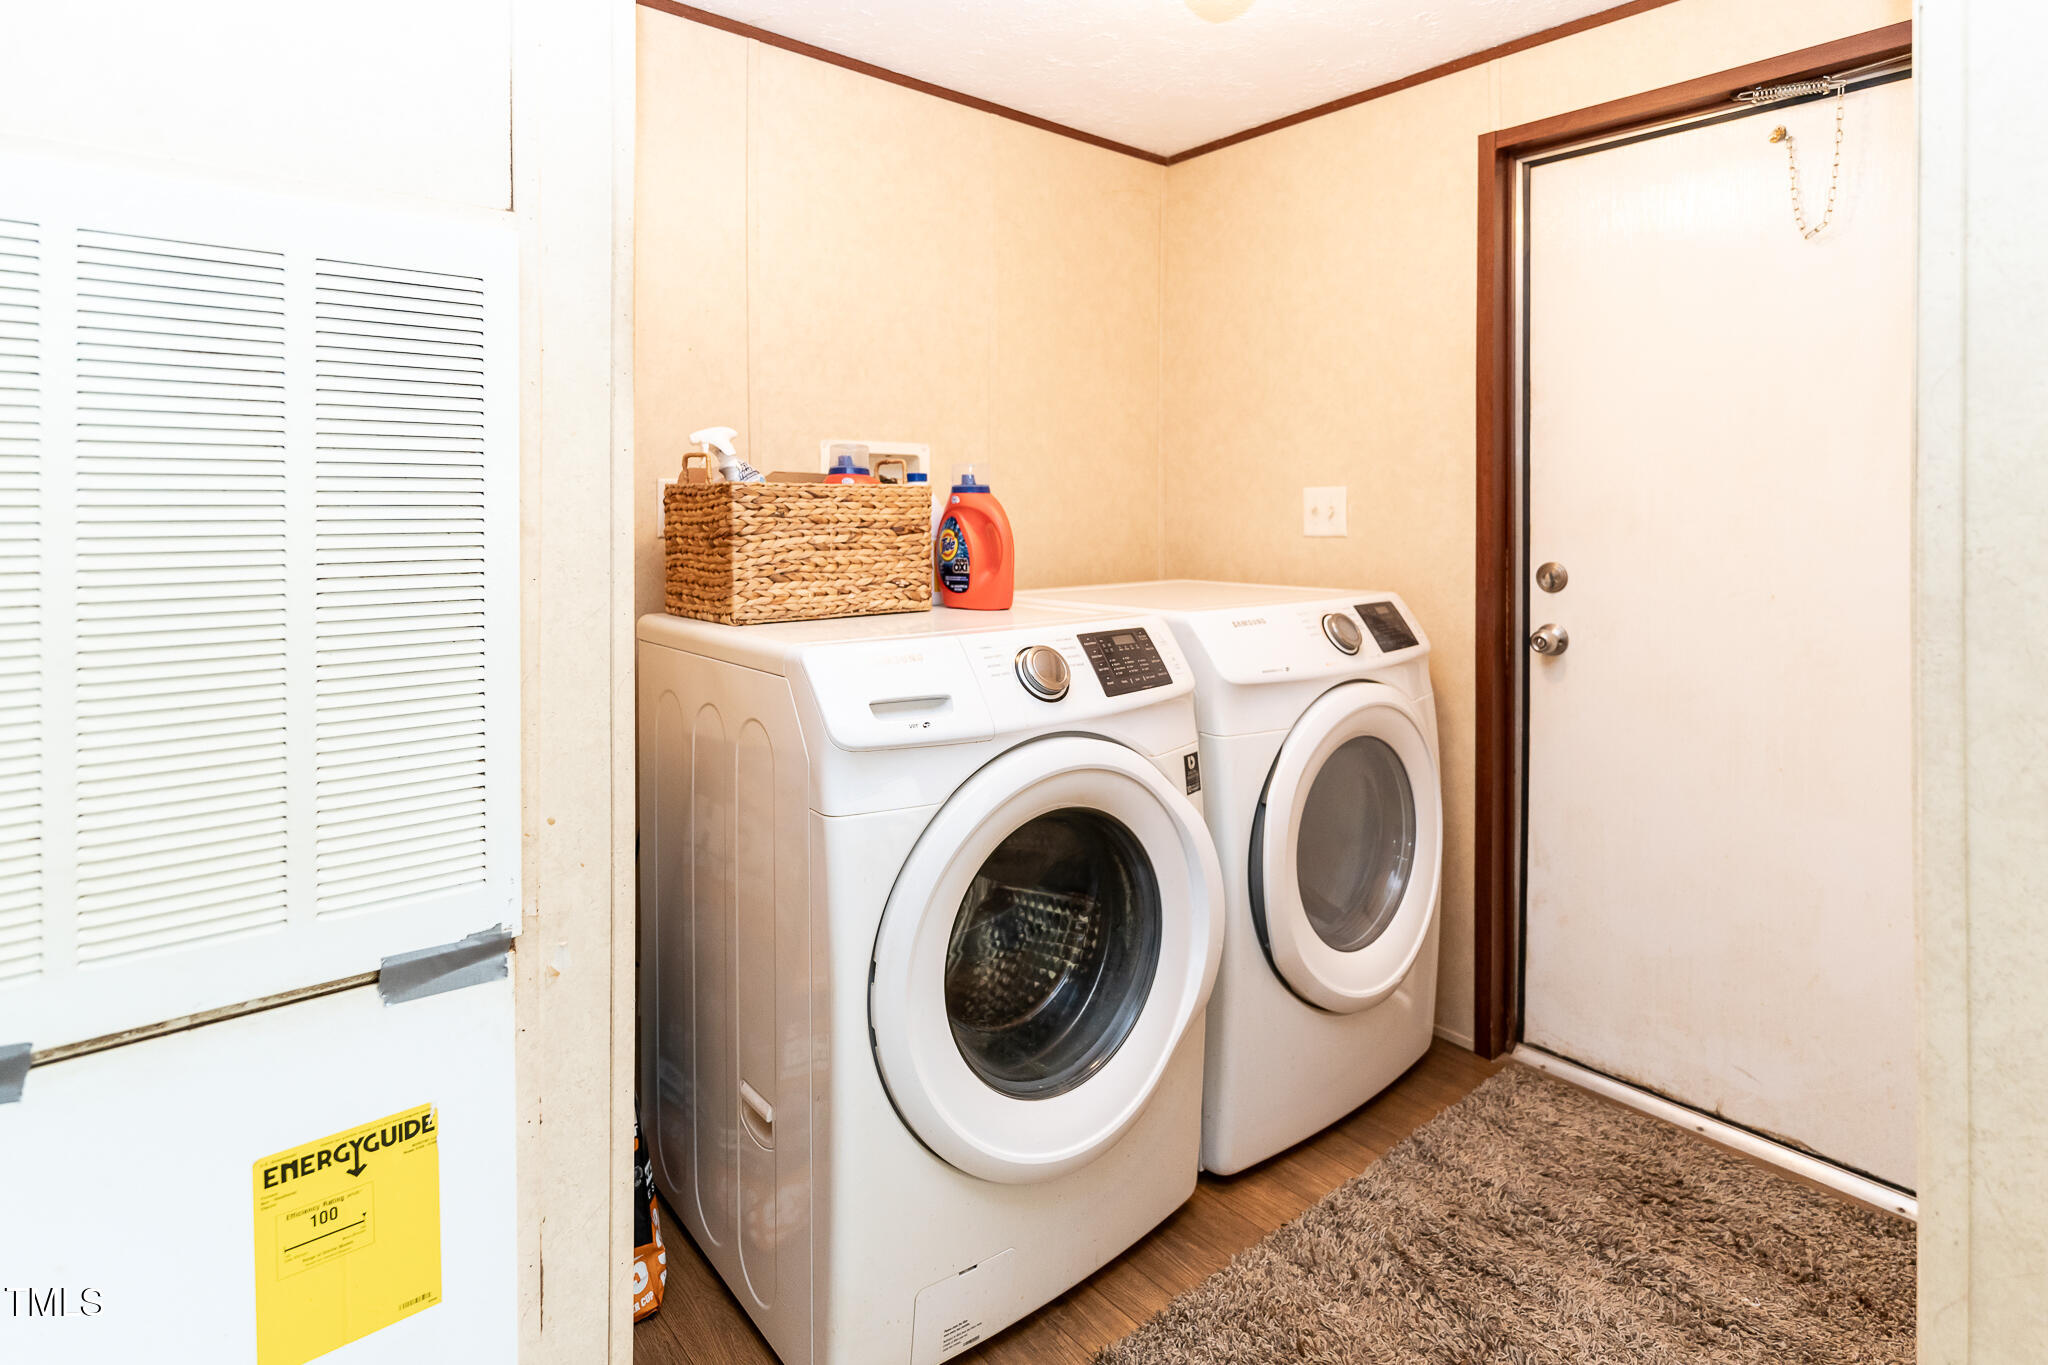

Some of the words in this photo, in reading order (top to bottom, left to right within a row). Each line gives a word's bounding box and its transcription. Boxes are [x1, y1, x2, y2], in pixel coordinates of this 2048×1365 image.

[1231, 617, 1267, 628] SAMSUNG
[263, 1113, 436, 1190] ENERGYGUIDE
[310, 1206, 338, 1227] 100
